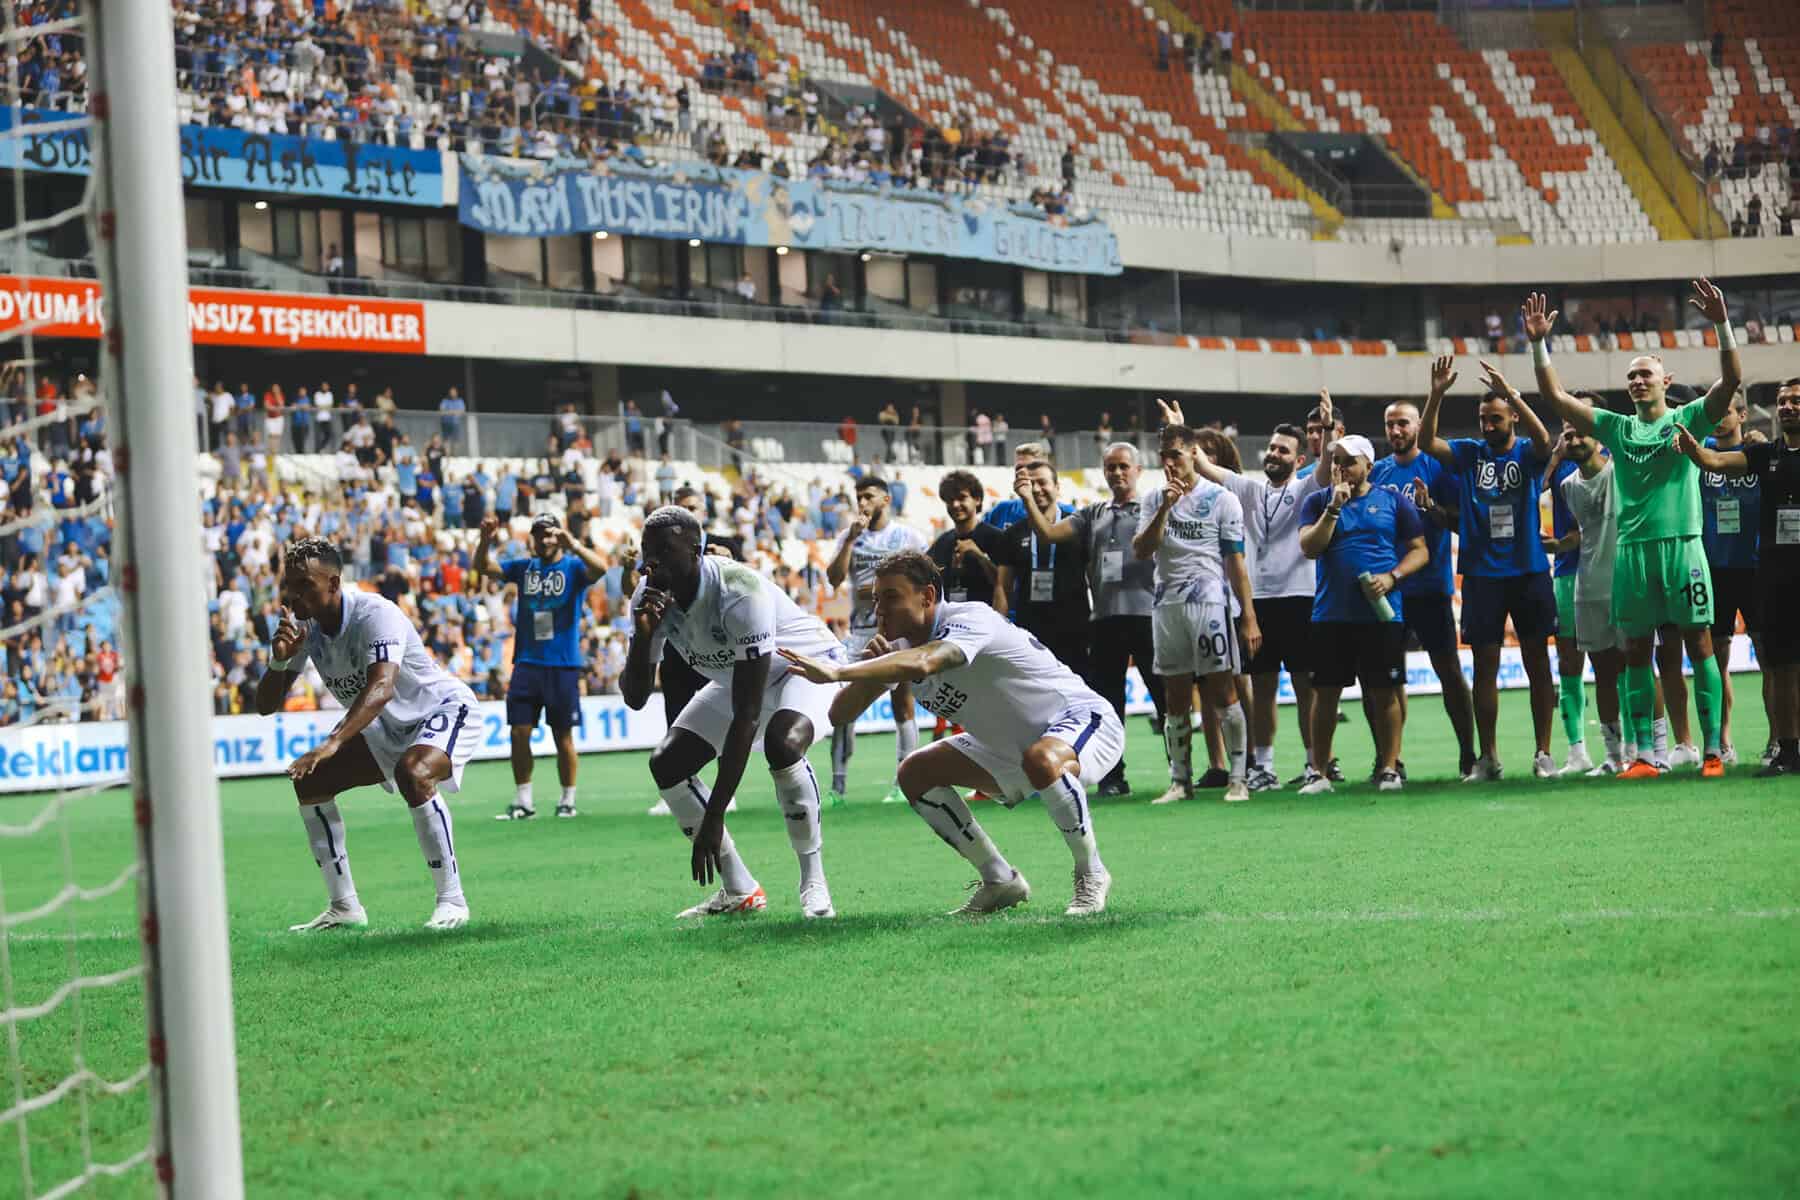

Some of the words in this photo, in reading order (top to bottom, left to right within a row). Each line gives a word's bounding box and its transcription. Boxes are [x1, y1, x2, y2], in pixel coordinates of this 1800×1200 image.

[257, 304, 421, 345] TEŞEKKÜRLER
[1680, 582, 1709, 608] 18
[1199, 632, 1227, 658] 90
